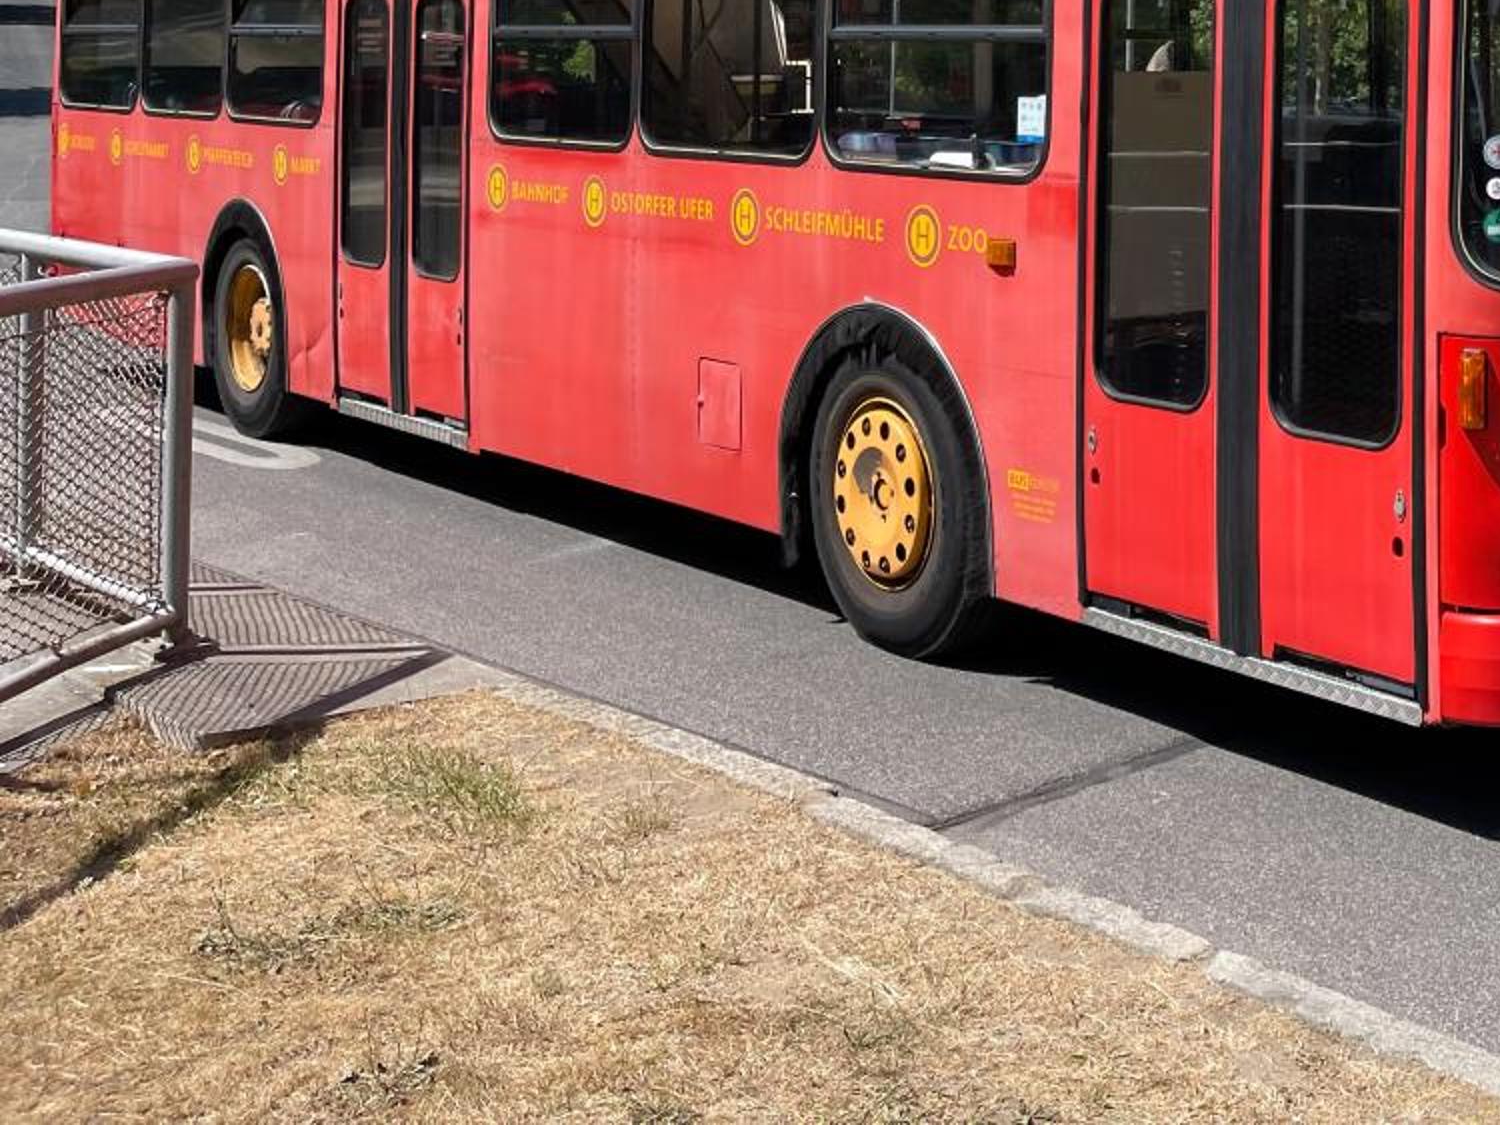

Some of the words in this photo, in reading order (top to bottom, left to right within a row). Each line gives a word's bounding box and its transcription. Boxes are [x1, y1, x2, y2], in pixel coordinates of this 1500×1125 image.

[512, 181, 569, 204] BAHNHOF
[610, 192, 676, 218] OSTORFER
[681, 197, 714, 220] UFER
[765, 206, 884, 243] SCHLEIFMÜHLE
[947, 225, 989, 254] ZOO
